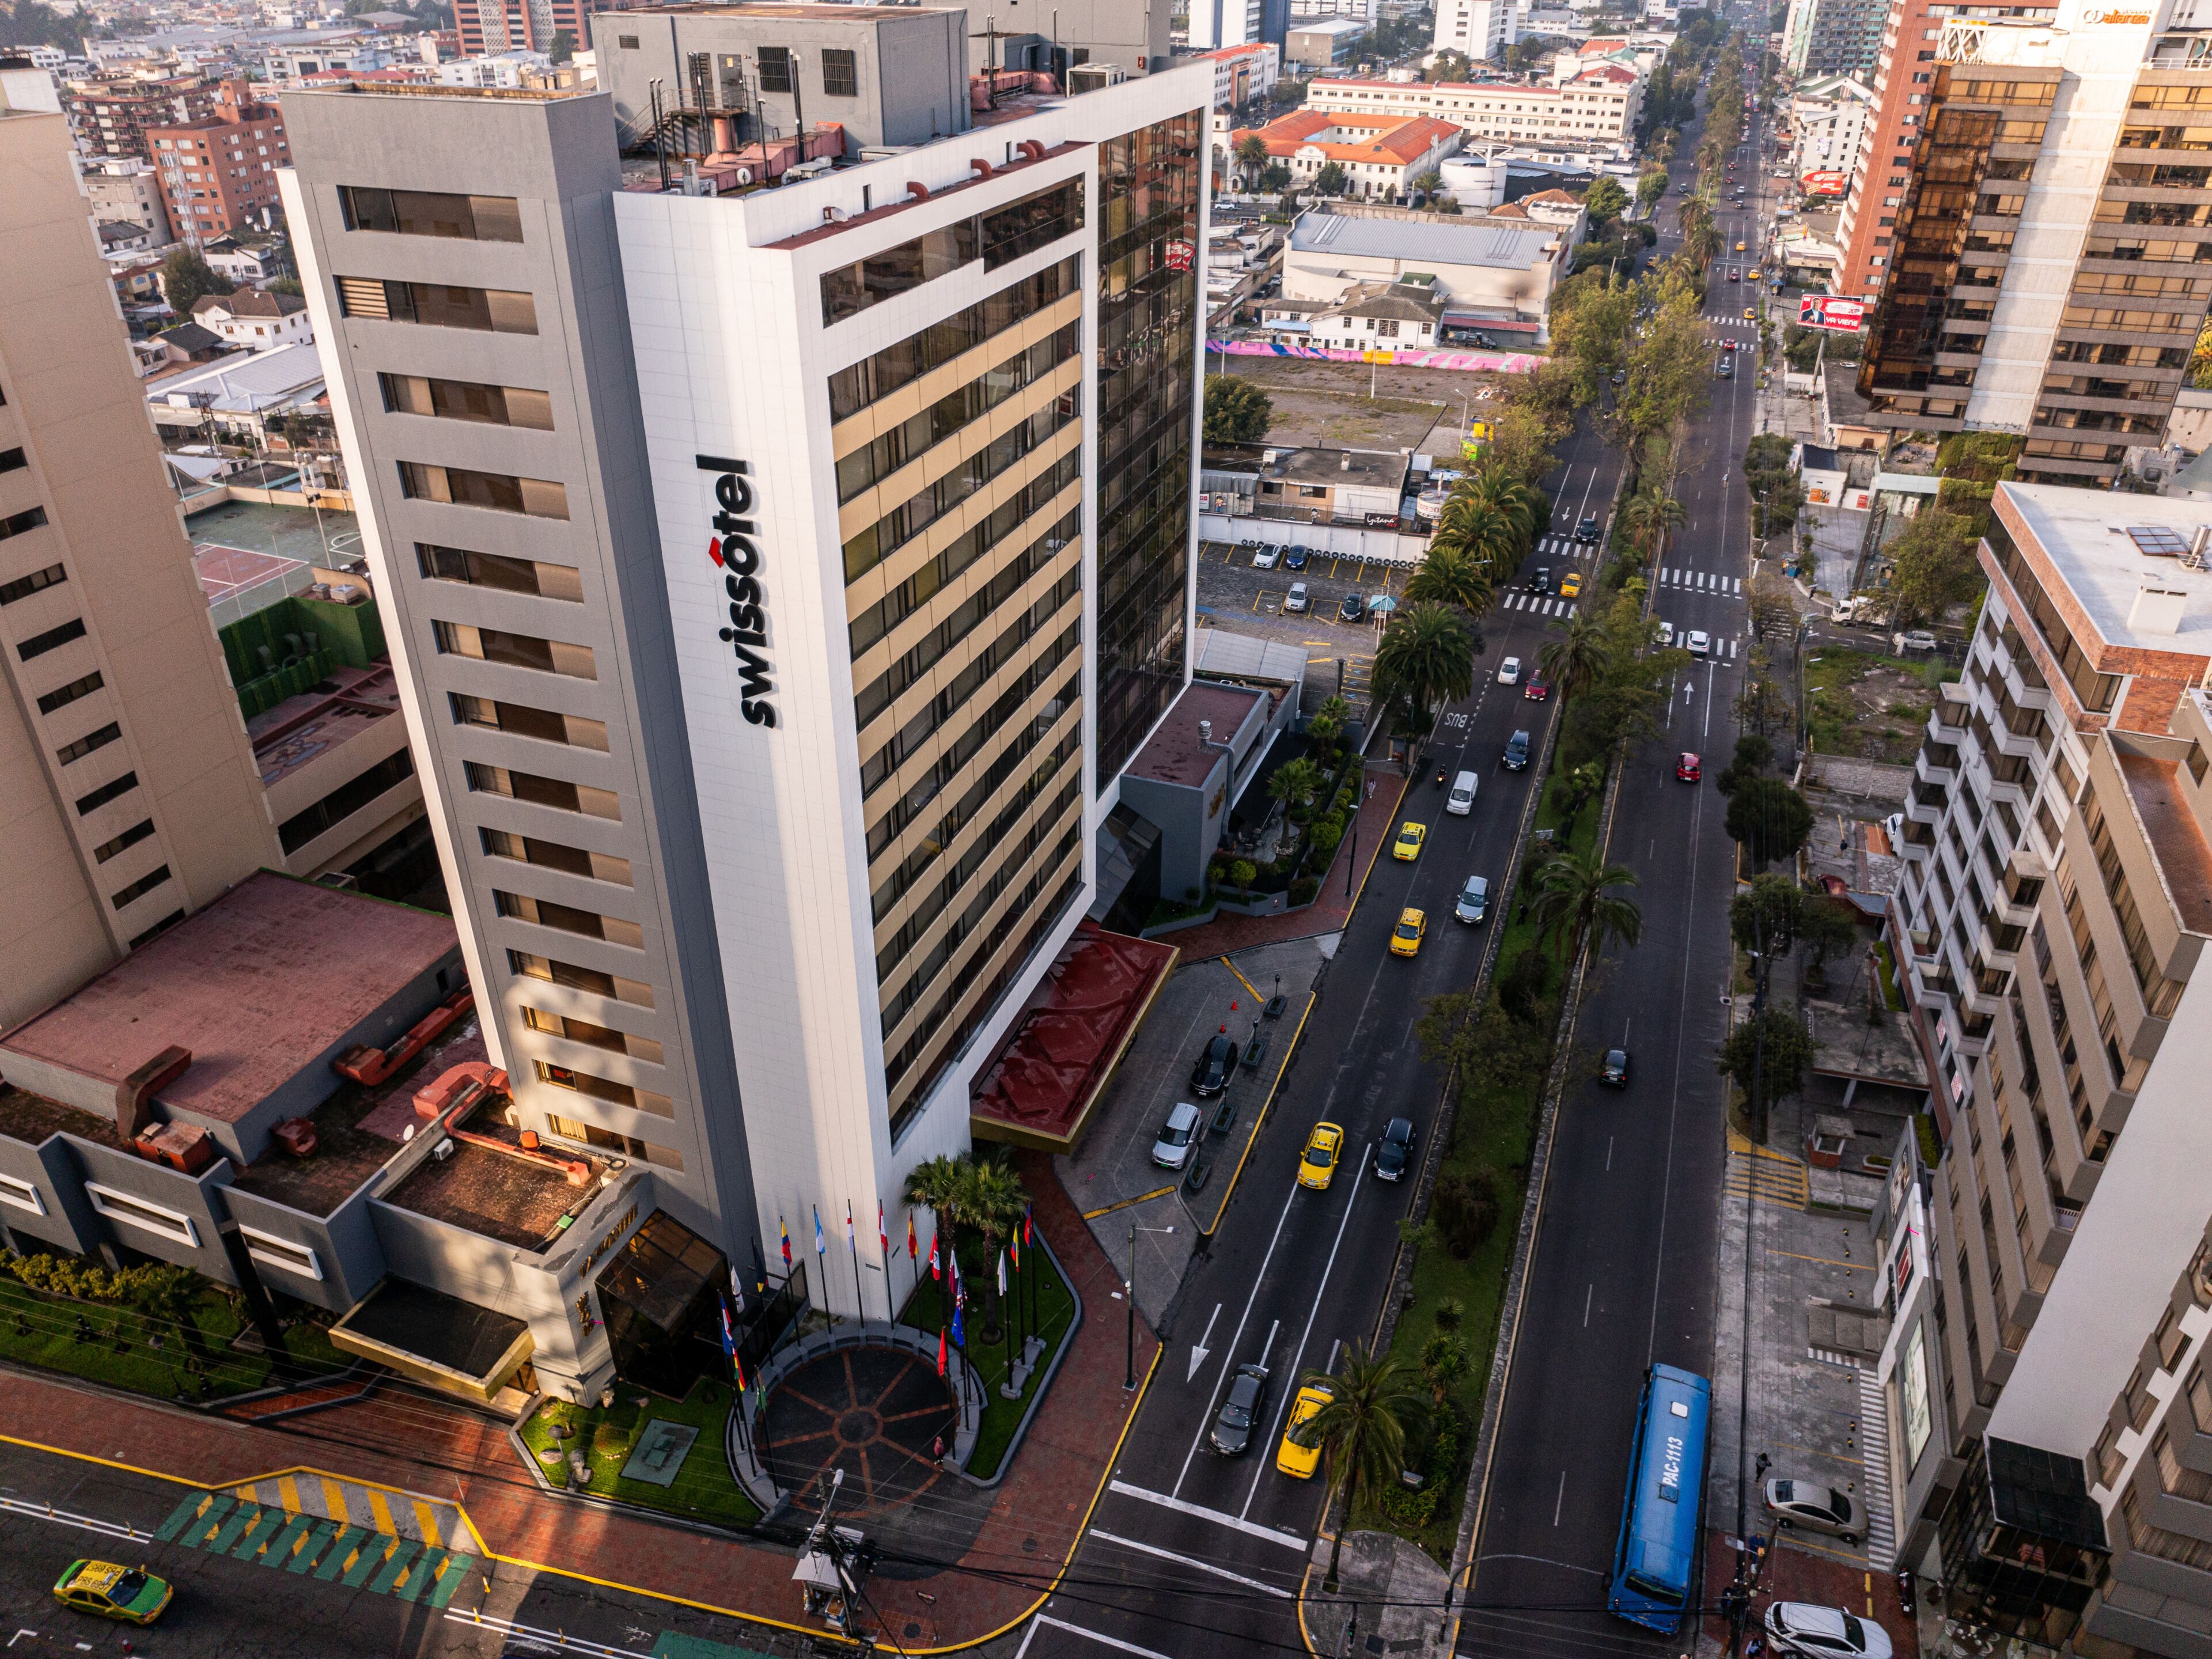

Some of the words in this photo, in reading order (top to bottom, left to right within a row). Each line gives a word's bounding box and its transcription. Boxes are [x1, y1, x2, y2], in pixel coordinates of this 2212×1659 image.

[2102, 9, 2150, 24] alianza
[1825, 316, 1836, 324] YA
[1837, 317, 1859, 327] VIENE
[1444, 712, 1469, 728] BUS
[1662, 1437, 1683, 1487] PAC-1113
